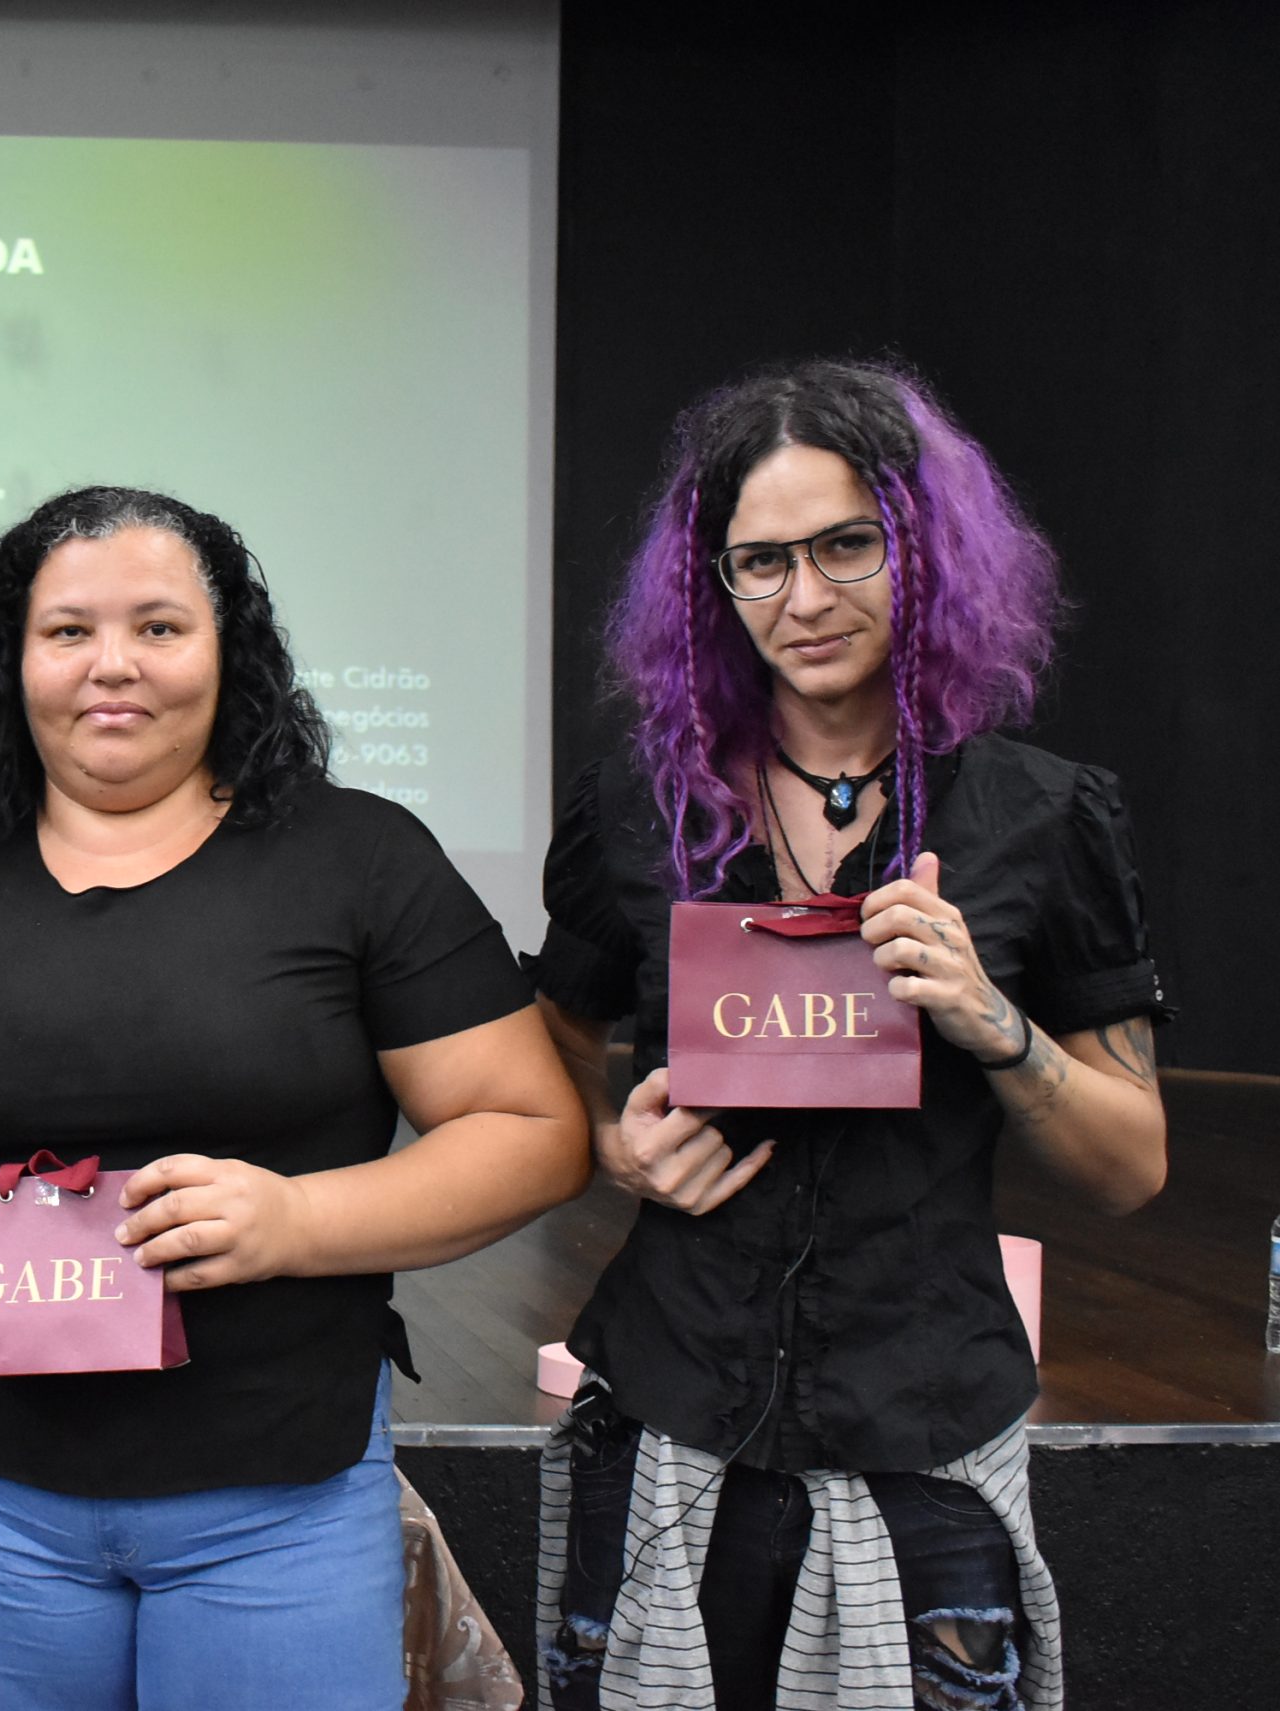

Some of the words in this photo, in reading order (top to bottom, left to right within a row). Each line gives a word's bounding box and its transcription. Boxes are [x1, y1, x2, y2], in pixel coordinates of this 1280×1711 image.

[343, 666, 430, 689] Cidrão
[322, 705, 430, 733] negócios
[712, 993, 879, 1038] GABE
